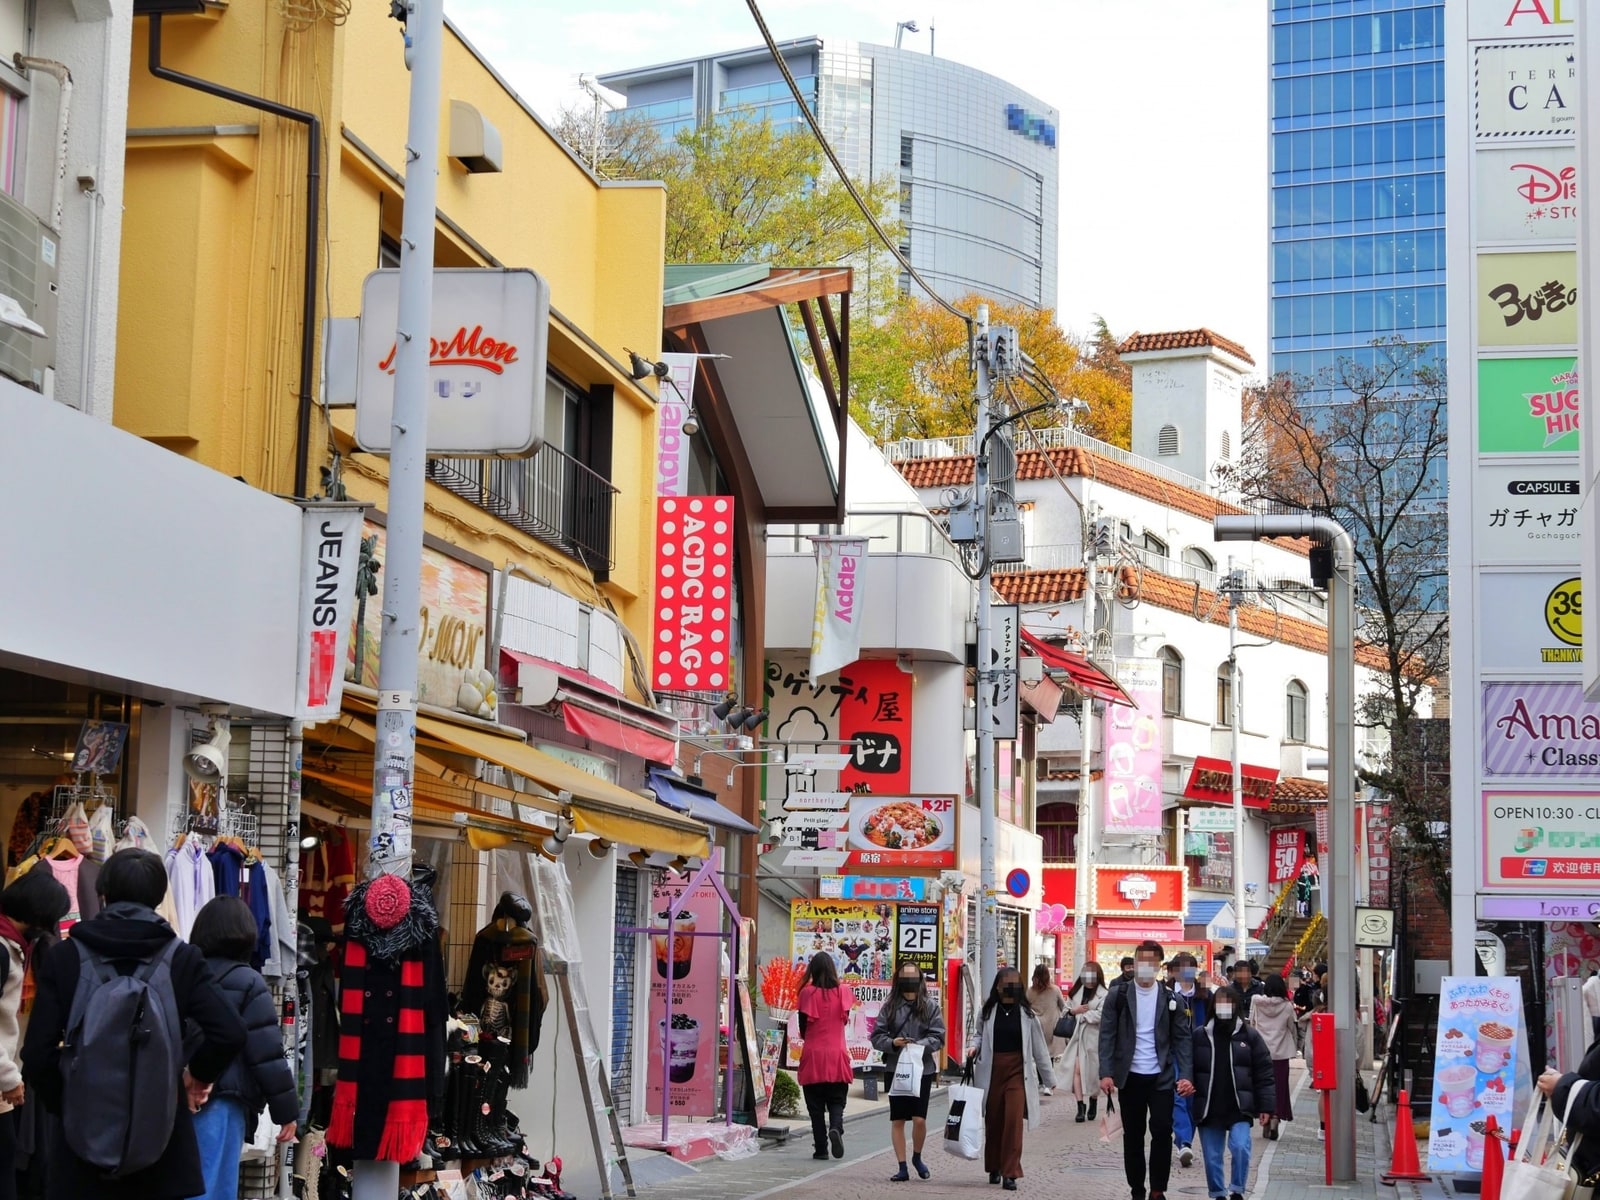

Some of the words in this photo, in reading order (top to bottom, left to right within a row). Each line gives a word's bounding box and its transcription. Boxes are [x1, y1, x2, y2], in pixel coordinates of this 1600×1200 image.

[1516, 483, 1571, 493] CAPSULE
[1489, 508, 1578, 528] ガチャガ
[682, 513, 706, 599] ACDC
[313, 520, 343, 627] JEANS
[679, 604, 703, 671] RAG
[392, 695, 400, 703] 5
[1497, 699, 1600, 740] Ama
[856, 738, 898, 768] ドナ
[1542, 746, 1600, 766] Class
[799, 797, 836, 805] northerly
[934, 800, 952, 811] 2F
[1268, 803, 1308, 814] BODY
[1276, 833, 1298, 845] SALE
[1275, 848, 1297, 867] 50
[1277, 867, 1295, 880] OFF
[920, 906, 938, 914] store
[1540, 902, 1579, 916] LOVE
[904, 928, 932, 949] 2F
